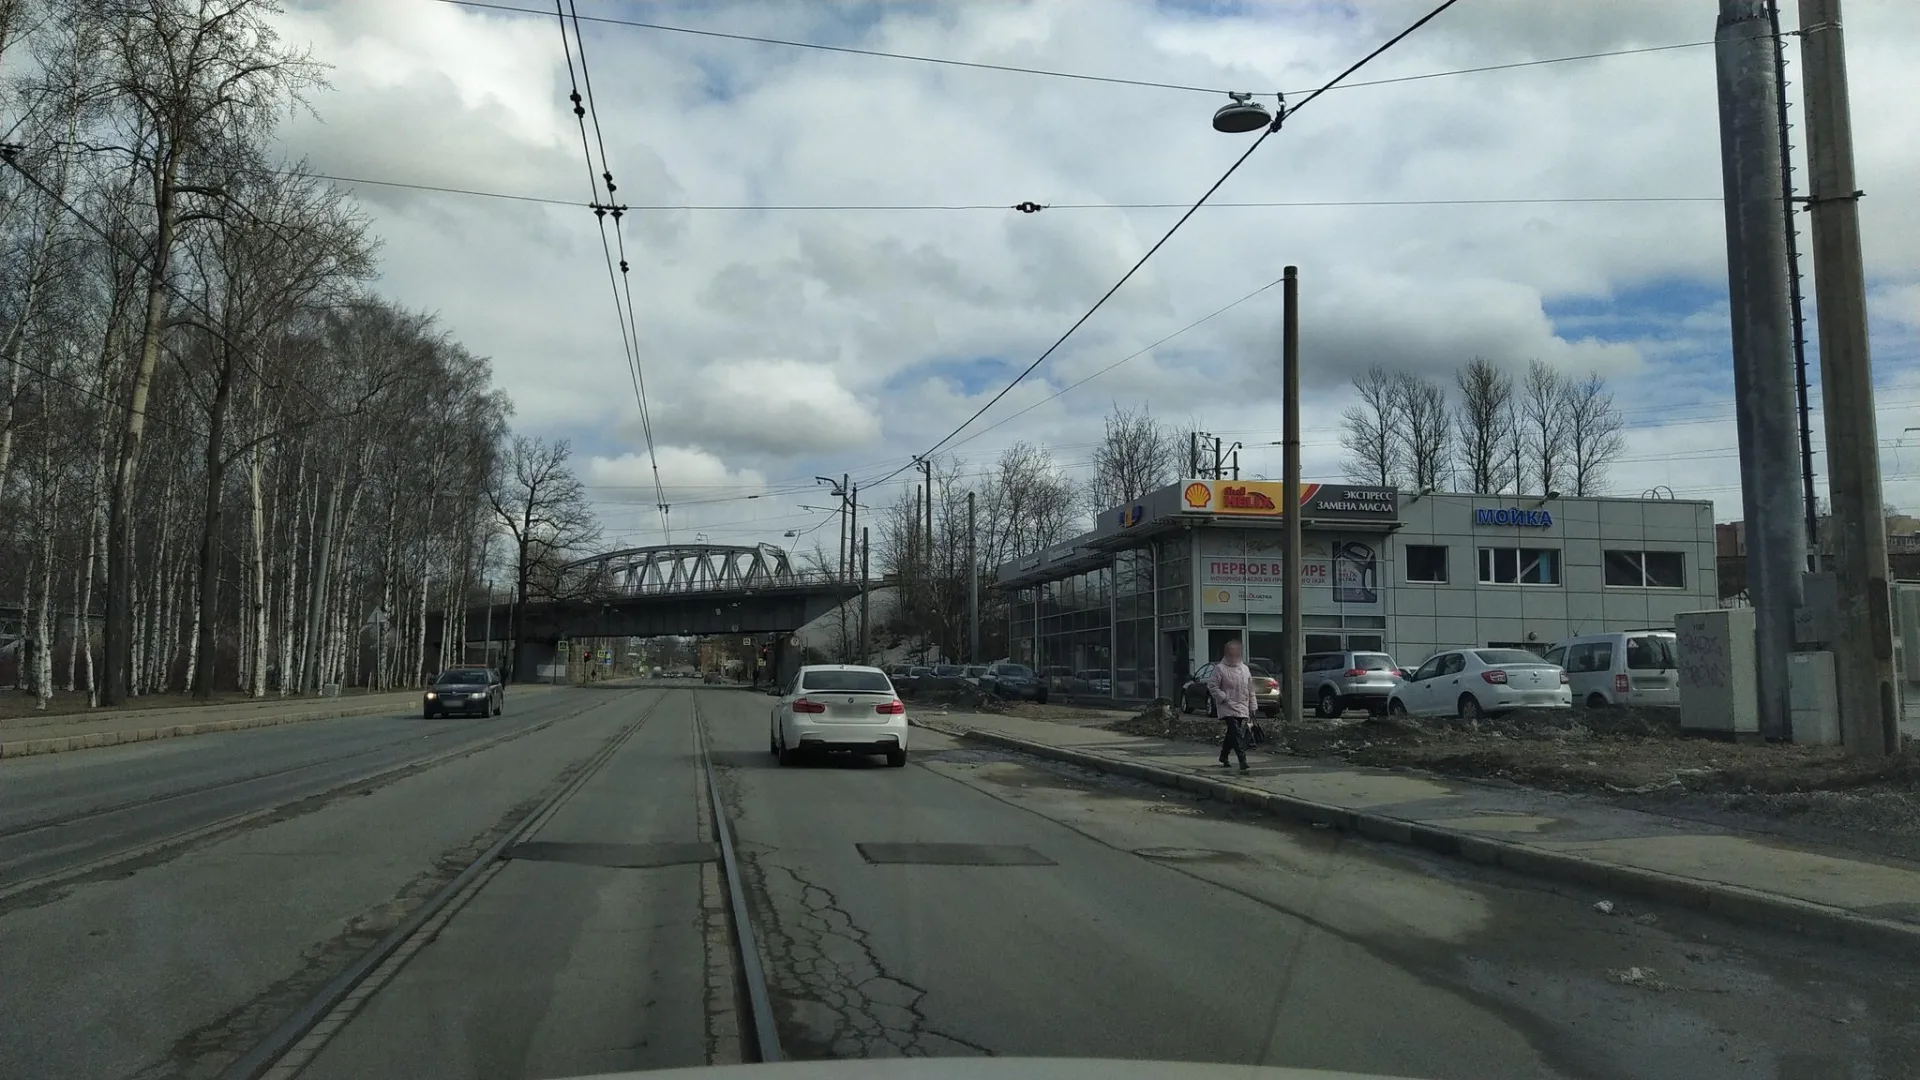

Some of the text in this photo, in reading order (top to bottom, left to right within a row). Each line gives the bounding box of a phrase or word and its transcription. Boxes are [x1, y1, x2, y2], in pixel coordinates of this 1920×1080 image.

[1224, 486, 1246, 496] Shell
[1343, 490, 1393, 501] ЭКСПРЕСС
[1317, 501, 1393, 512] ЗАМЕНА МАСЛА
[1476, 507, 1553, 527] МОЙКА
[1210, 562, 1326, 577] ПЕРВОЕ В ИРЕ
